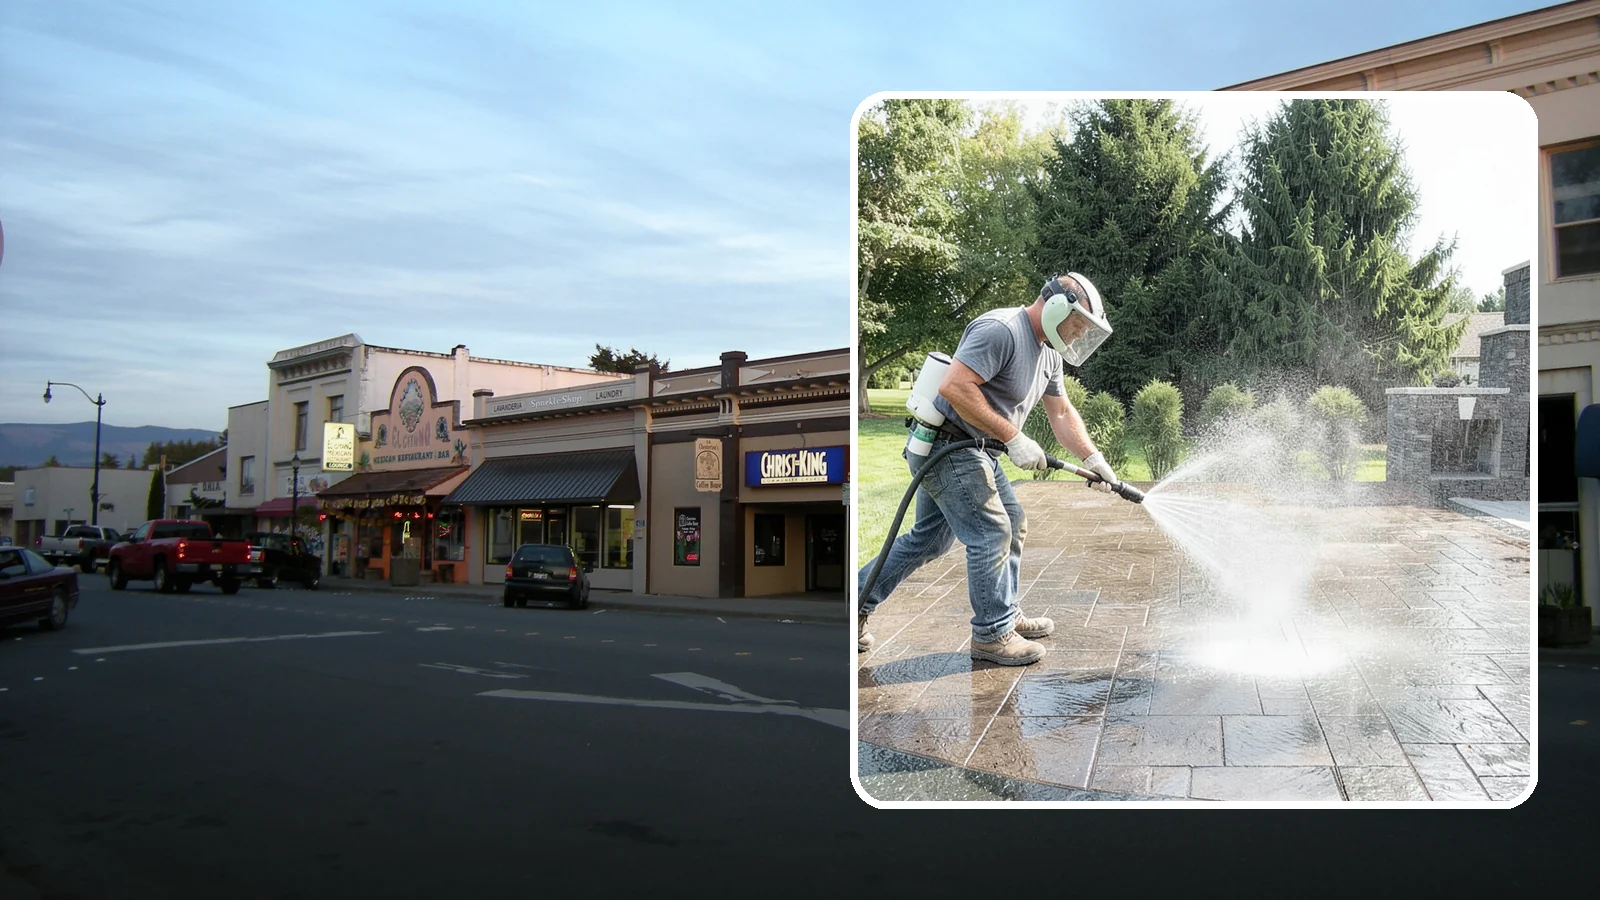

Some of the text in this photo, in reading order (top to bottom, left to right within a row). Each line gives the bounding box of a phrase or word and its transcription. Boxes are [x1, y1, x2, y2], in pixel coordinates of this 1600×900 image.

[493, 402, 522, 412] LAVANDERIA
[561, 394, 582, 404] Shop
[596, 389, 623, 400] LAUNDRY
[373, 455, 396, 464] MEXICAN
[397, 451, 433, 462] RESTAURANT
[437, 450, 450, 459] BAR
[761, 450, 827, 478] CHRIST KING
